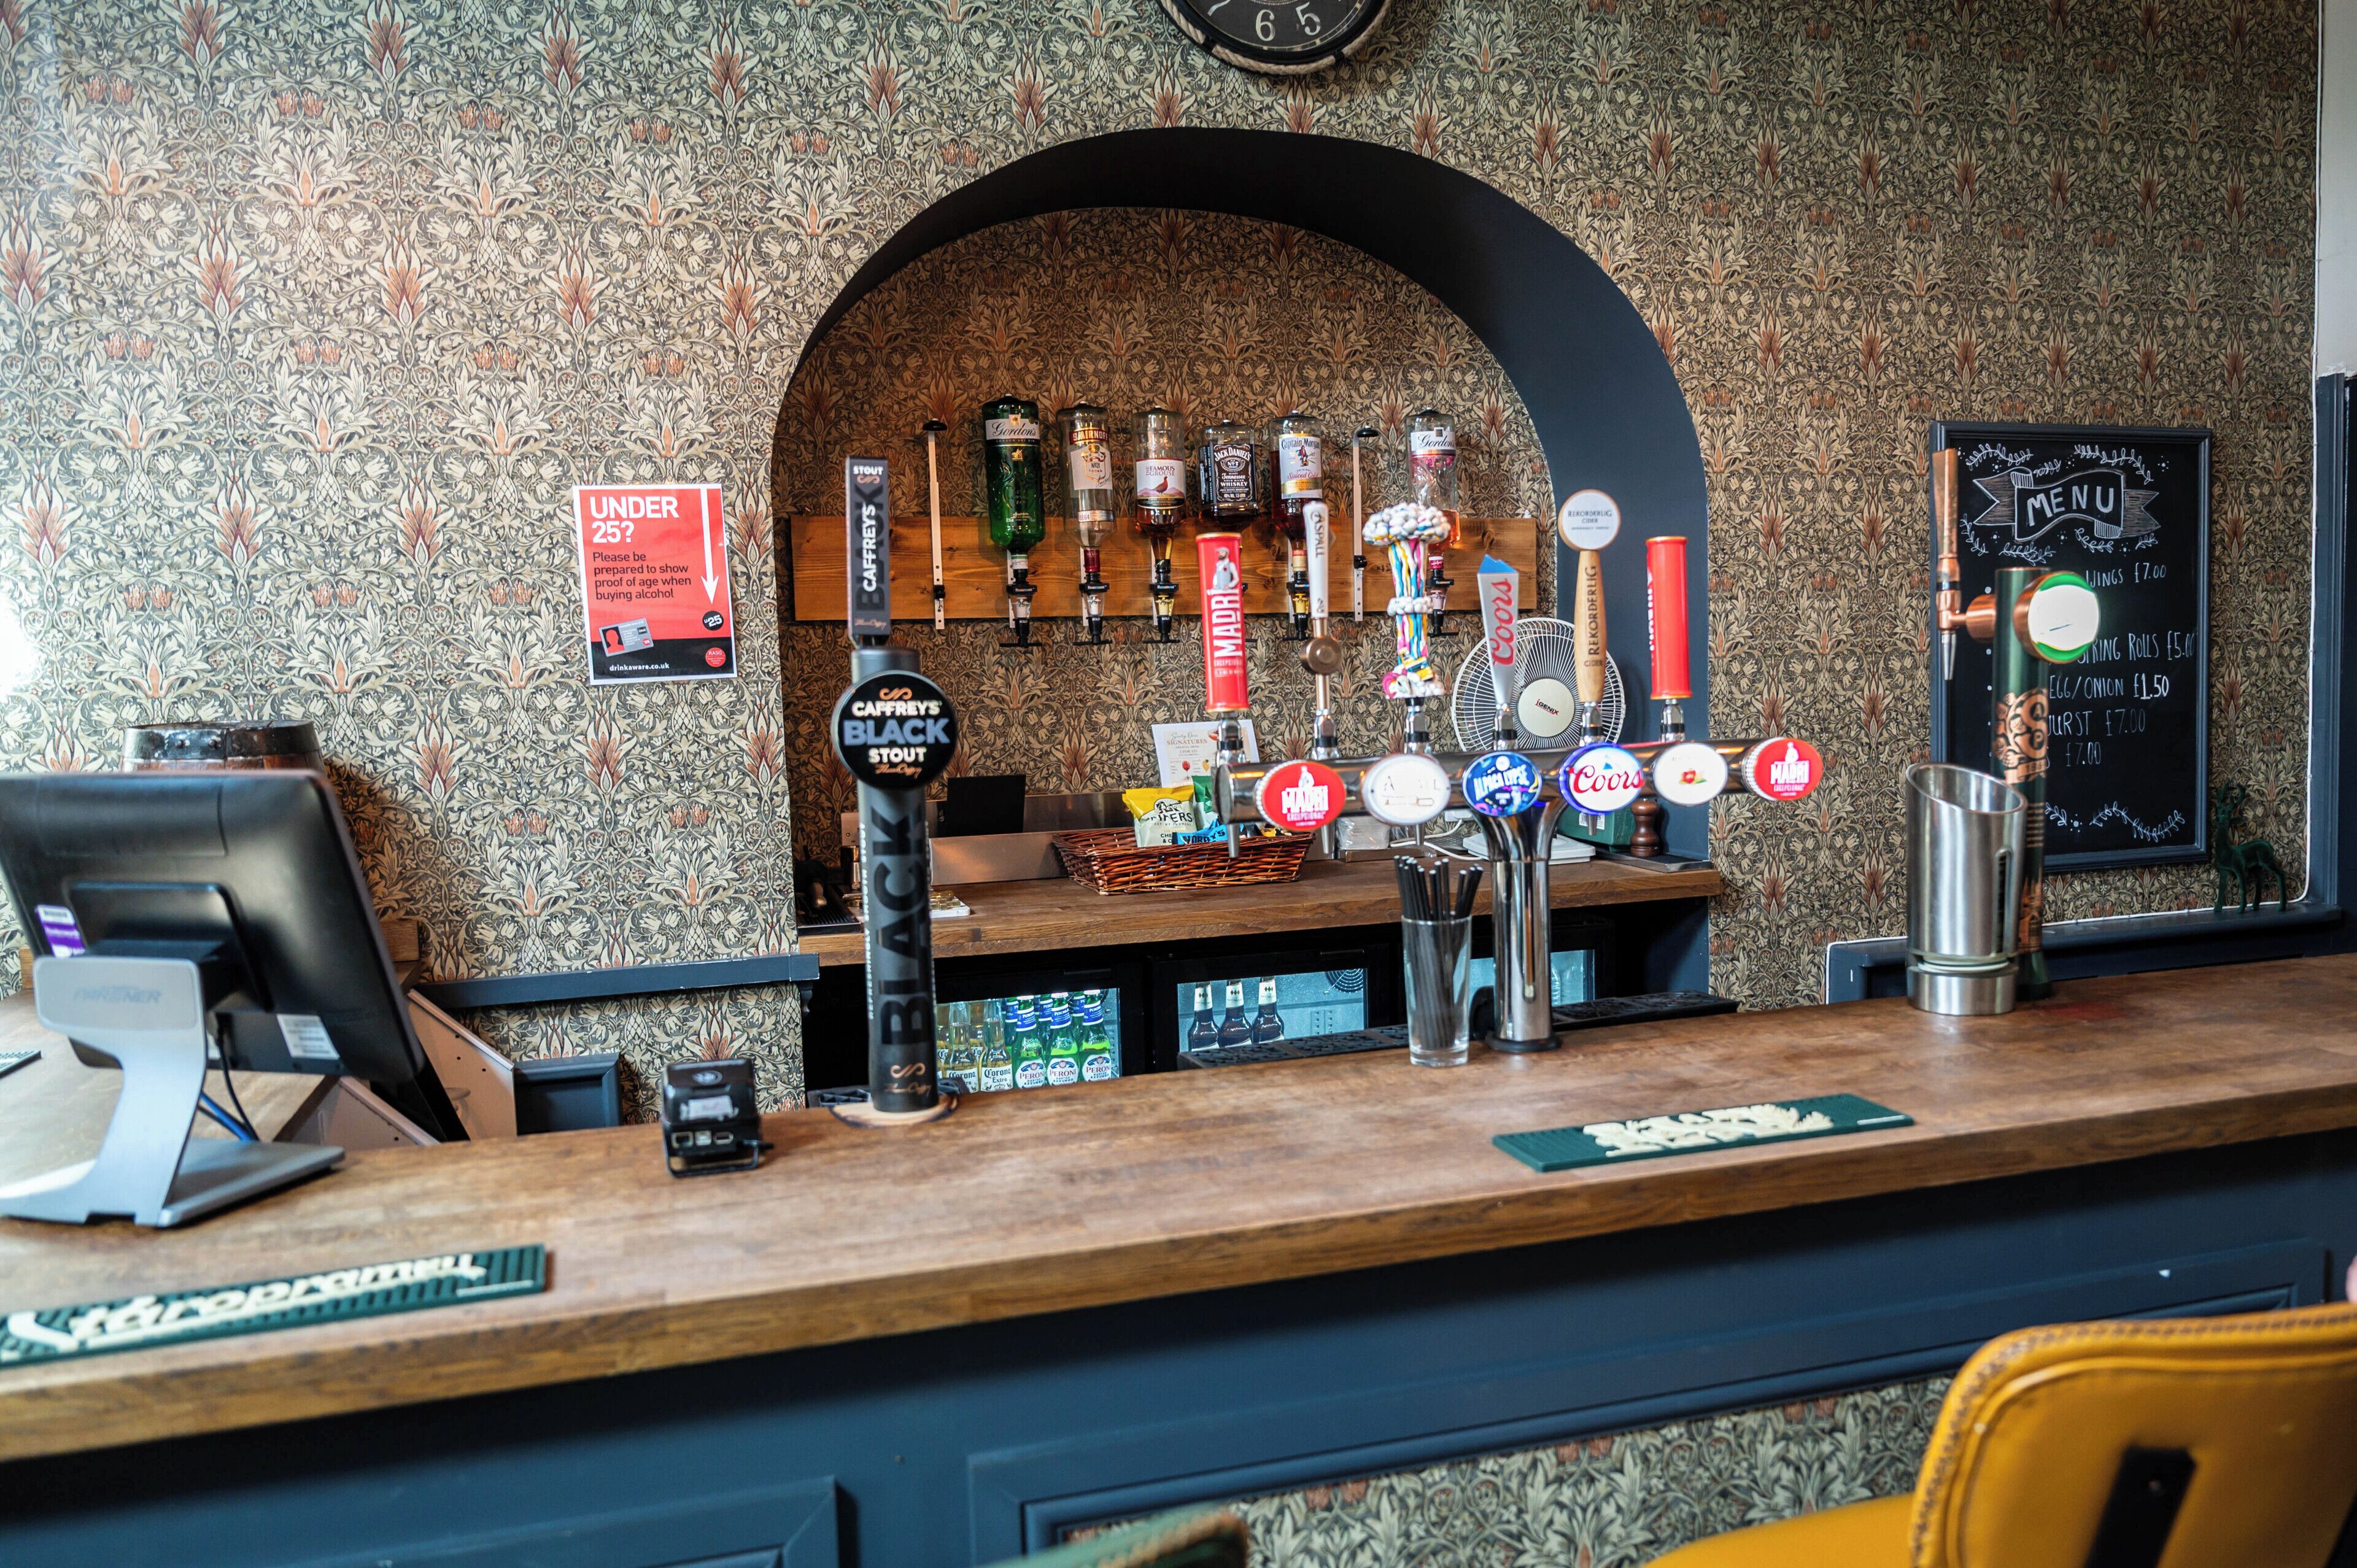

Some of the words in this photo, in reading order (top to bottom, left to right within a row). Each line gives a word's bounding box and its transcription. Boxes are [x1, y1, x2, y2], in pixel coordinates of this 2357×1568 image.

[1255, 9, 1275, 41] 6
[1296, 2, 1321, 36] 5
[992, 422, 1037, 436] Gordon's
[1214, 449, 1228, 461] JACK
[1228, 447, 1251, 461] DANIEL'S
[1281, 438, 1302, 449] Captain
[853, 466, 883, 476] STOUT
[590, 496, 679, 519] UNDER
[2027, 484, 2115, 527] MENU
[592, 520, 635, 543] 25?
[1310, 510, 1326, 558] ASPALL
[593, 552, 630, 562] Please
[633, 552, 646, 561] be
[594, 564, 643, 577] prepared
[646, 565, 656, 574] to
[659, 565, 689, 574] show
[2135, 562, 2167, 583] £7.00
[595, 577, 623, 590] proof
[626, 577, 637, 587] of
[639, 579, 659, 589] age
[661, 577, 691, 586] when
[596, 590, 633, 602] buying
[635, 589, 674, 600] alcohol
[1585, 565, 1600, 655] REKORDERLIG
[1489, 578, 1515, 666] Coors
[2129, 633, 2159, 661] ROLLS
[610, 663, 670, 672] drinkaware.co.uk
[2134, 673, 2169, 700] £1.50
[852, 700, 940, 717] CAFFREY'S
[843, 717, 951, 746] BLACK
[2106, 709, 2146, 736] £7.00
[869, 747, 926, 763] STOUT
[2065, 741, 2101, 767] £7.00
[1569, 765, 1644, 794] Coors
[871, 805, 935, 1045] BLACK
[984, 1068, 1011, 1079] Corona
